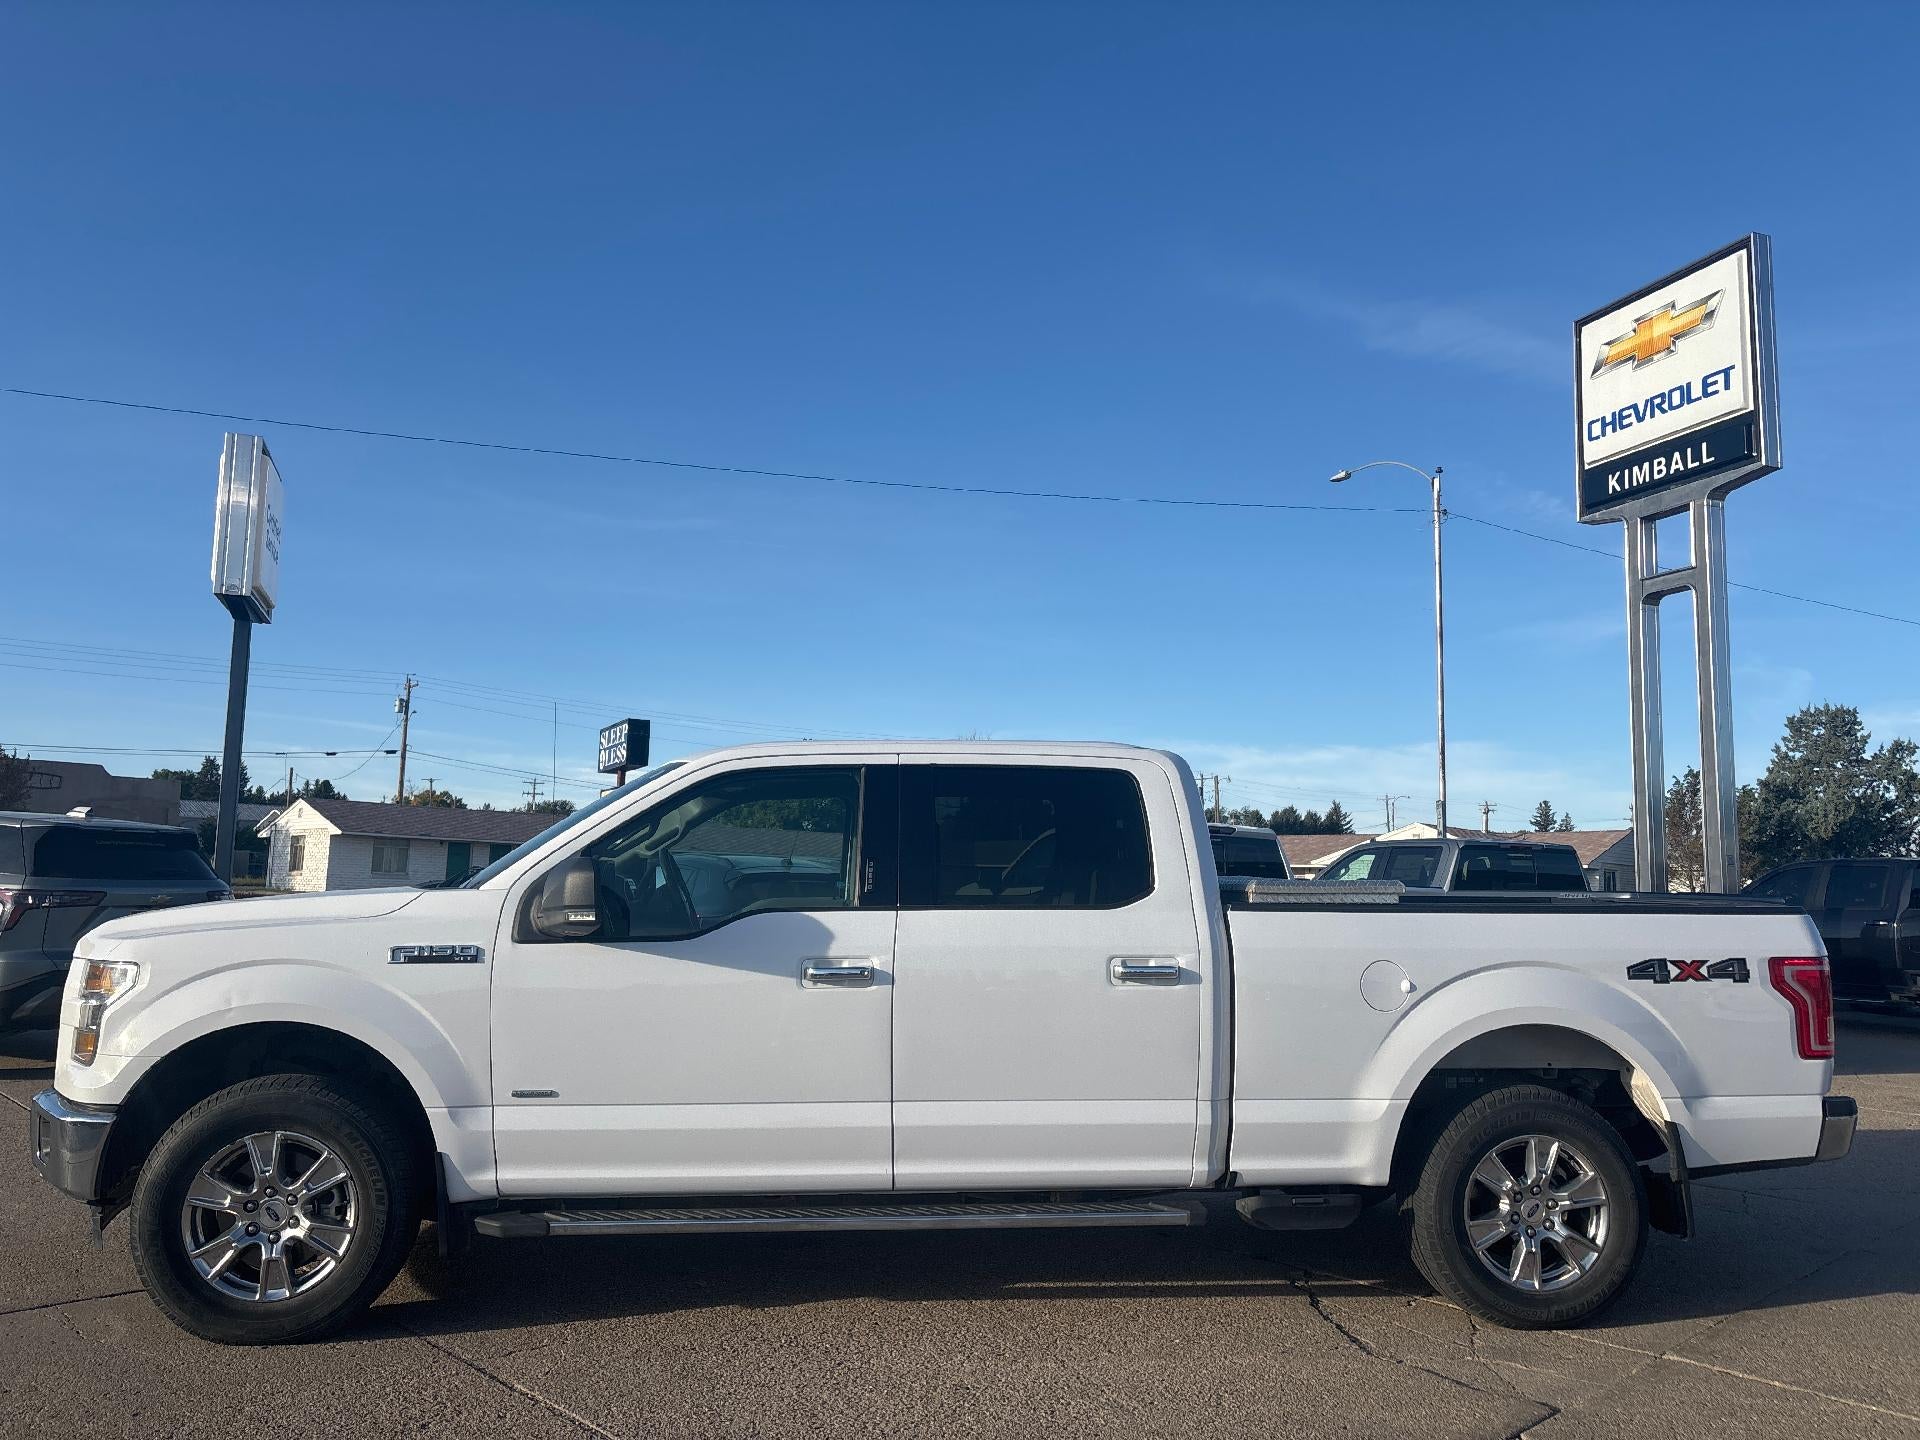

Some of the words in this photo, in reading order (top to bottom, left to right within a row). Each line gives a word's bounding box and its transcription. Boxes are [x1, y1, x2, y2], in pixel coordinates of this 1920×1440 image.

[1587, 364, 1736, 442] CHEVROLET
[1607, 442, 1715, 495] KIMBALL
[600, 723, 628, 749] SLEEP
